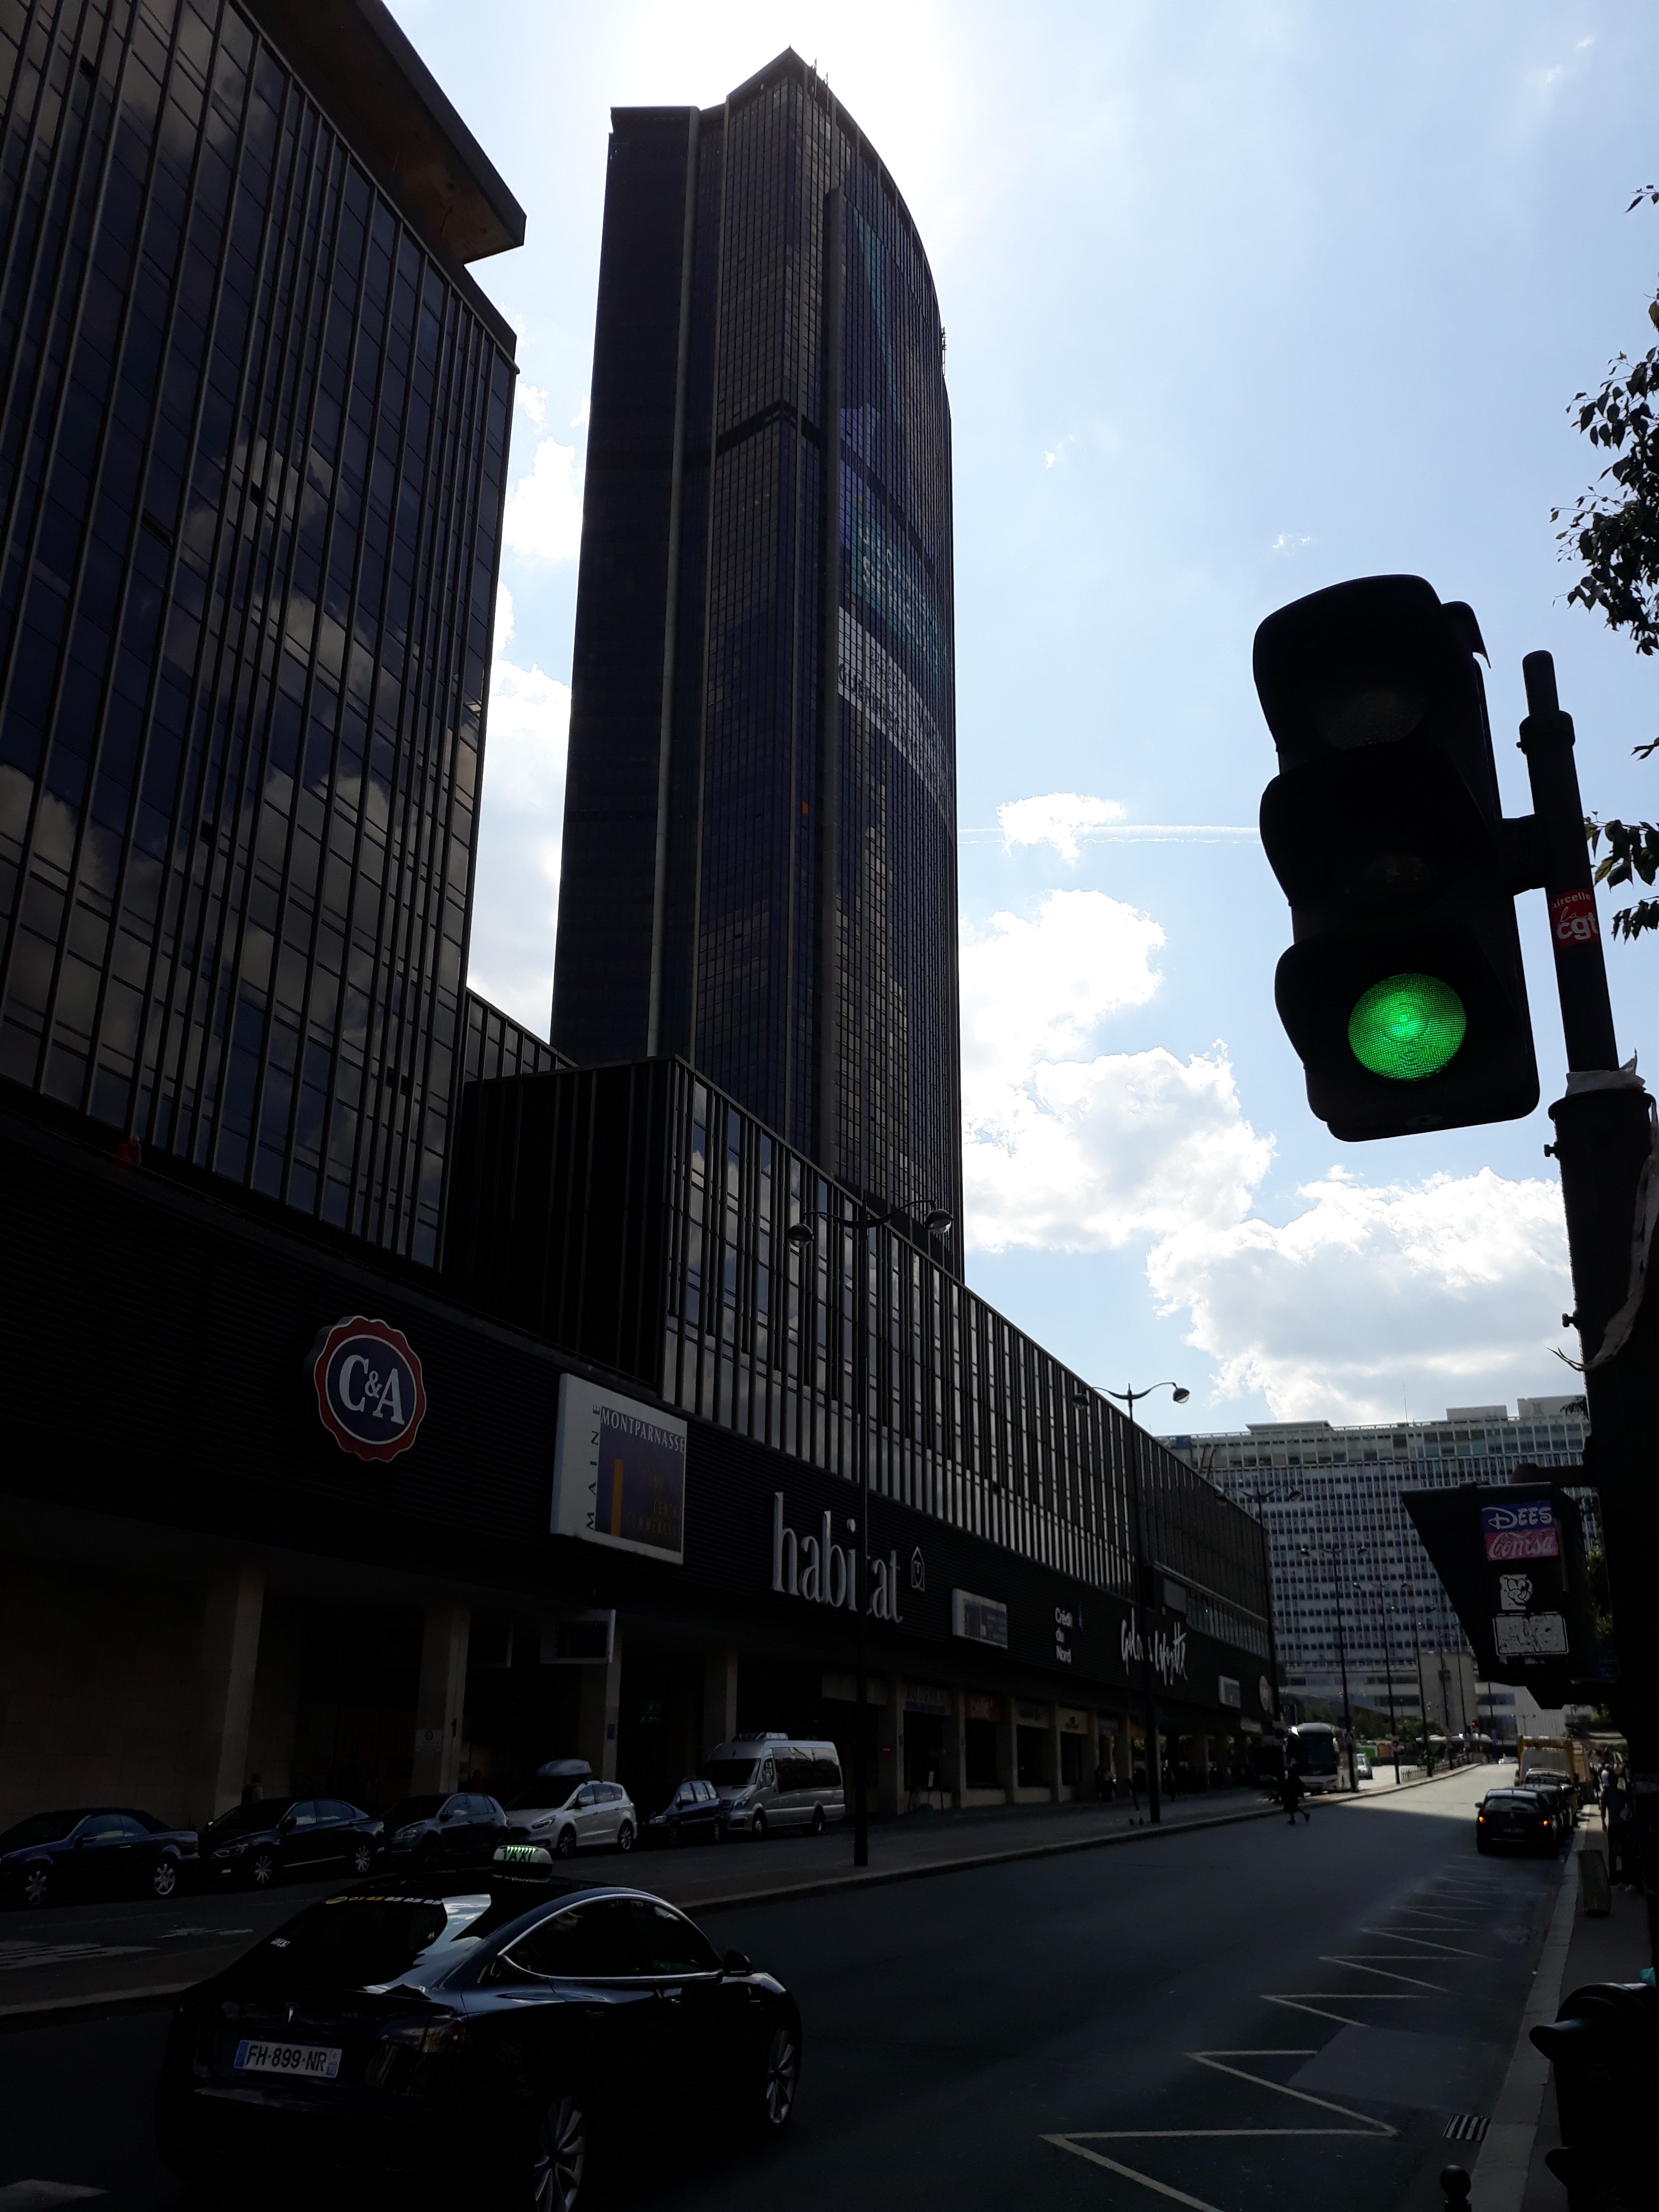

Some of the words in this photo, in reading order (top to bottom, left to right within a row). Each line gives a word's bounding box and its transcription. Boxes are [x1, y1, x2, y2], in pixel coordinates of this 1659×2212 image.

[1557, 912, 1599, 940] cgt
[339, 1354, 405, 1425] C&A
[601, 1407, 685, 1453] MONTPARNASSE
[587, 1404, 601, 1530] MAINE
[771, 1491, 903, 1623] habiat
[504, 1847, 533, 1861] TAXI
[246, 2045, 327, 2072] FH-899-NR
